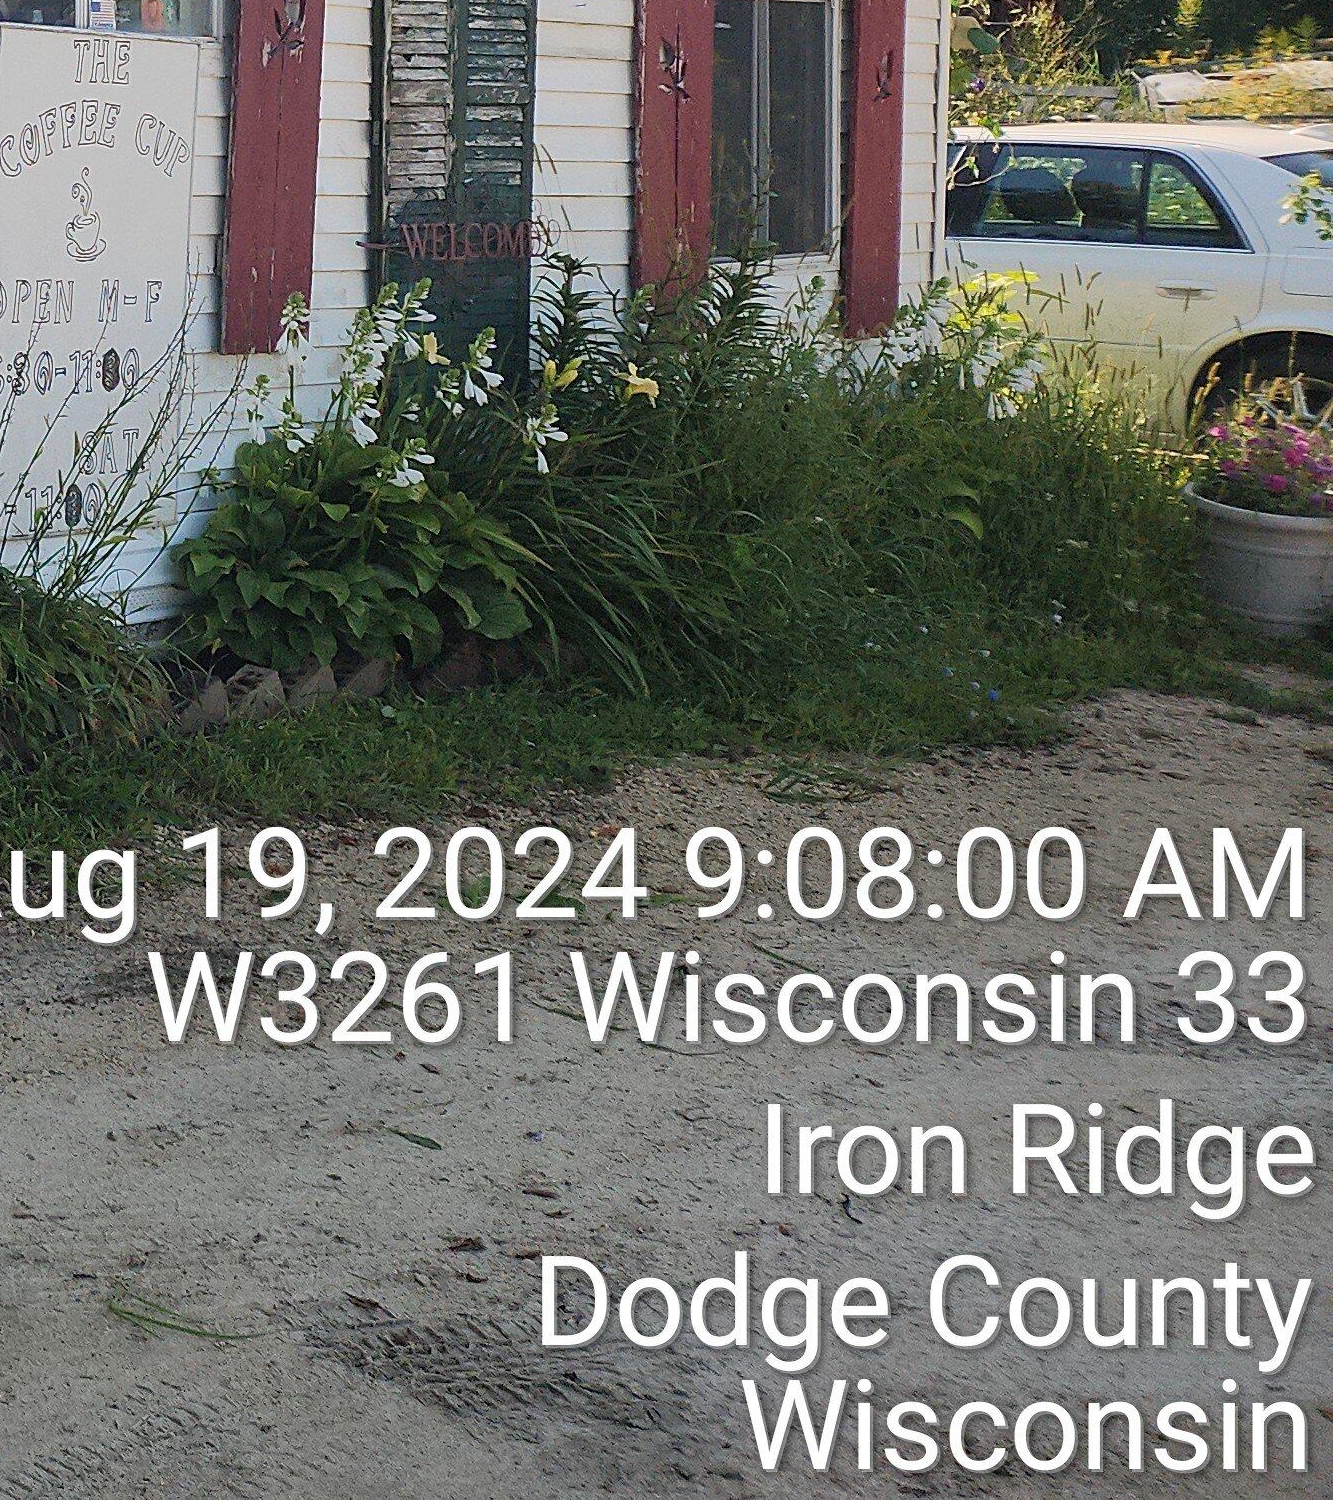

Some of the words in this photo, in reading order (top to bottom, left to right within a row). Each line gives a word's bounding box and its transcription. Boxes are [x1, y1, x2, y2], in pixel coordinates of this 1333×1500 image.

[73, 38, 131, 84] THE
[134, 113, 191, 178] CUP
[400, 222, 545, 260] WELCOME
[98, 279, 163, 323] M-F
[79, 428, 139, 475] SAT
